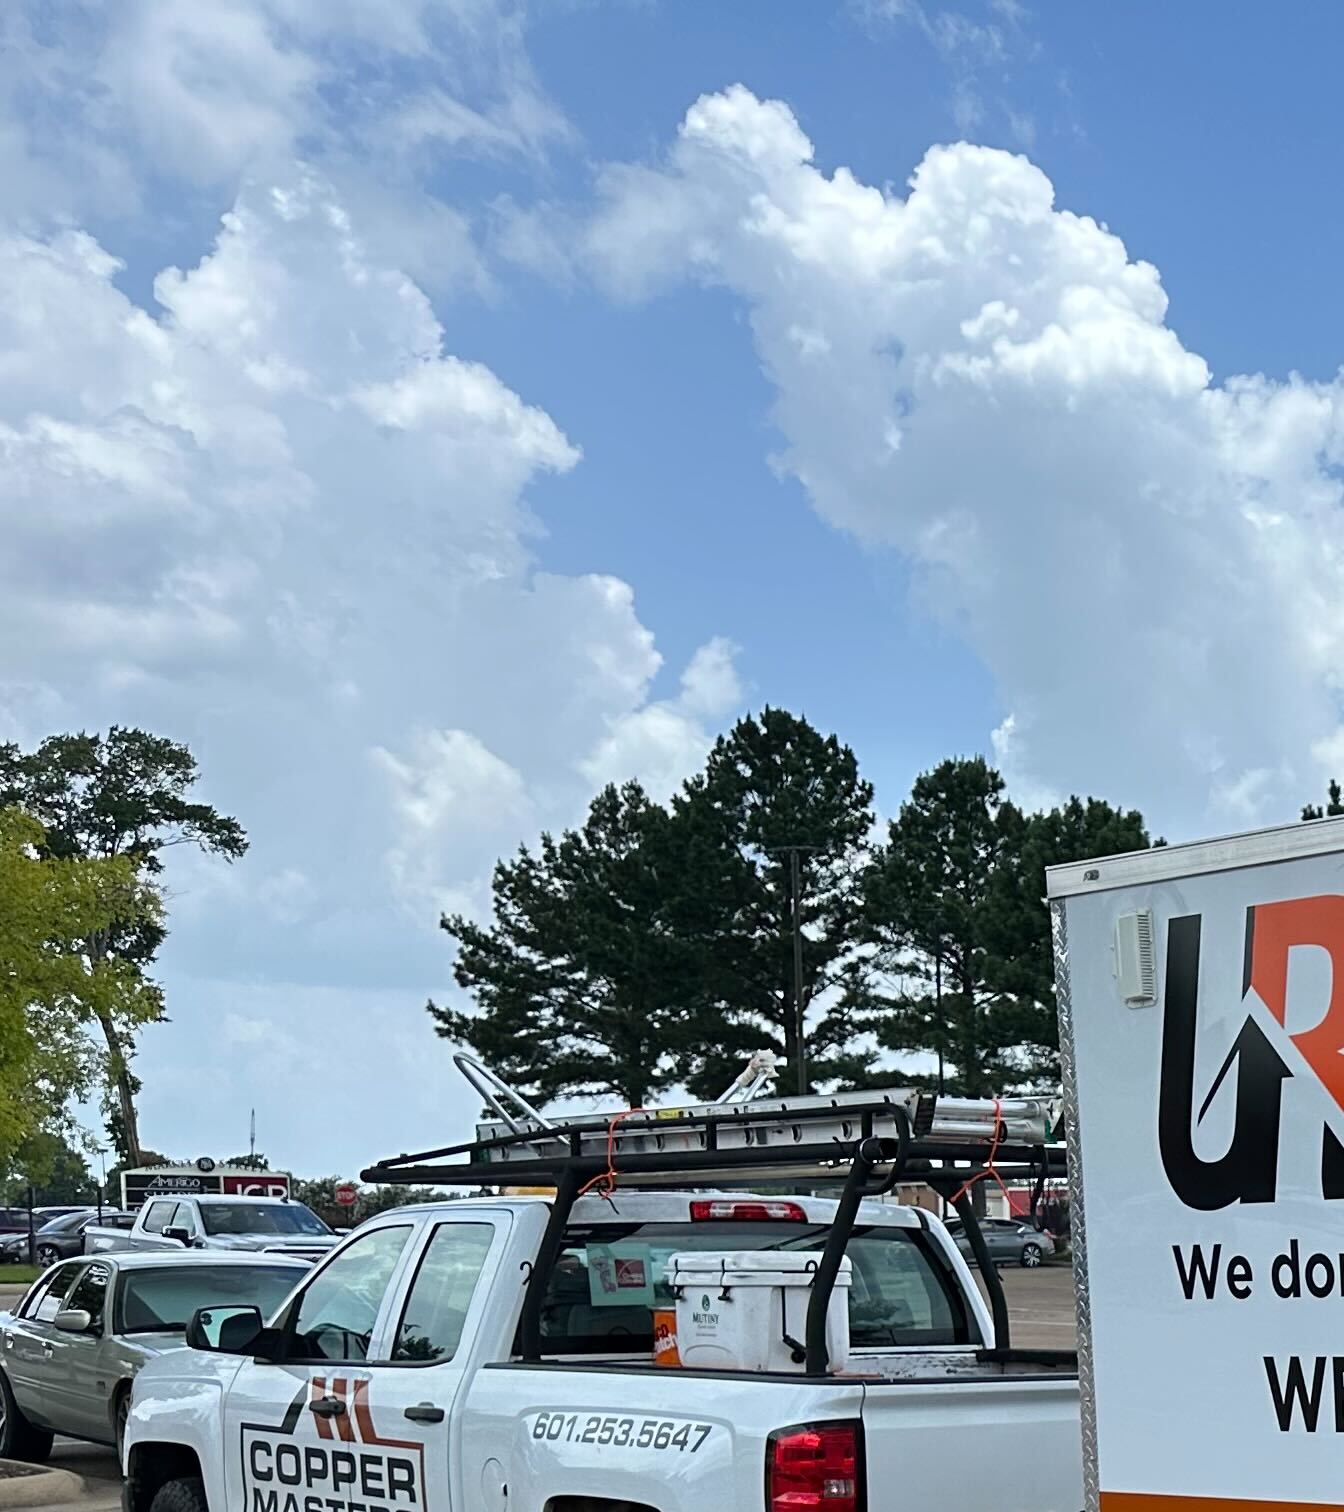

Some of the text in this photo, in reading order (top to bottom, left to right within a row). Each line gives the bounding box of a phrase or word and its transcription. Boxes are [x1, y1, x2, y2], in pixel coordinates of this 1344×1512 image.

[1171, 1243, 1253, 1300] We
[533, 1412, 712, 1453] 601.253.5647
[250, 1440, 417, 1503] COPPER
